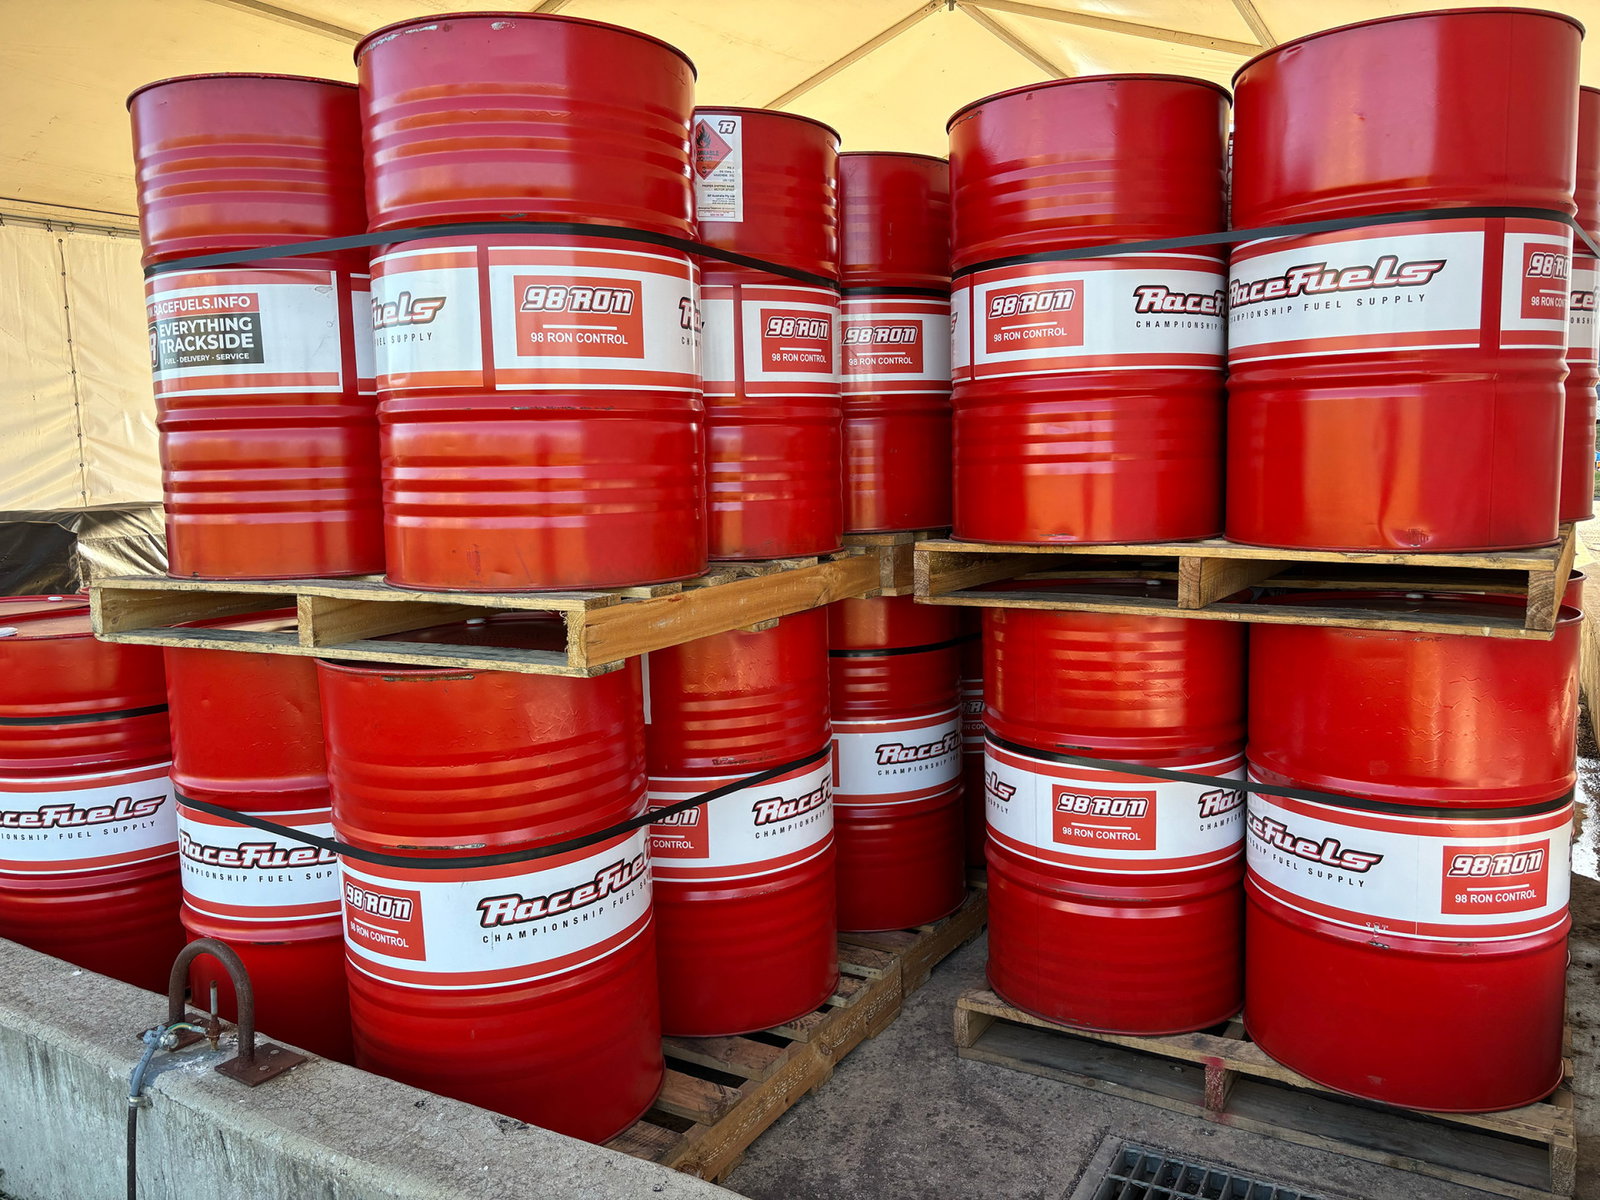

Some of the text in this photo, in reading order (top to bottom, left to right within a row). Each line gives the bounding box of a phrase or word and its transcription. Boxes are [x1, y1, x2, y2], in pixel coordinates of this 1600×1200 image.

[1526, 251, 1556, 279] 98
[520, 284, 635, 316] 98 RON
[988, 287, 1076, 319] 98 RON
[1304, 300, 1342, 311] FUEL
[1356, 294, 1425, 307] SUPPLY
[1531, 296, 1540, 306] 98
[1541, 297, 1555, 307] RON
[160, 317, 253, 338] EVERYTHING
[764, 315, 795, 340] 98
[842, 325, 919, 345] 98 RON
[993, 327, 1067, 343] 98 RON CONTROL
[1136, 320, 1218, 331] CHAMPIONSHIP
[160, 333, 255, 354] TRACKSIDE
[391, 332, 432, 344] SUPPLY
[530, 332, 628, 345] 98 RON CONTROL
[180, 354, 210, 363] DELIVERY
[215, 352, 250, 361] SERVICE
[771, 353, 827, 364] 98 RON CONTROL
[848, 356, 913, 366] 98 RON CONTROL
[878, 759, 947, 776] CHAMPIONSHIP
[1056, 792, 1149, 818] 98 RON
[59, 831, 92, 840] FUEL
[103, 820, 155, 836] SUPPLY
[755, 811, 826, 839] CHAMPIONSHIP
[1062, 826, 1141, 841] 98 RON CONTROL
[653, 839, 695, 850] CONTROL
[1272, 853, 1298, 871] FUEL
[1307, 867, 1364, 888] SUPPLY
[1446, 848, 1544, 878] 98 RON
[259, 874, 293, 883] FUEL
[346, 881, 413, 922] 98 RON
[1454, 889, 1537, 904] 98 RON CONTROL
[482, 906, 604, 944] CHAMPIONSHIP
[613, 889, 635, 909] FUEL
[357, 924, 369, 938] RON
[370, 930, 409, 948] CONTROL
